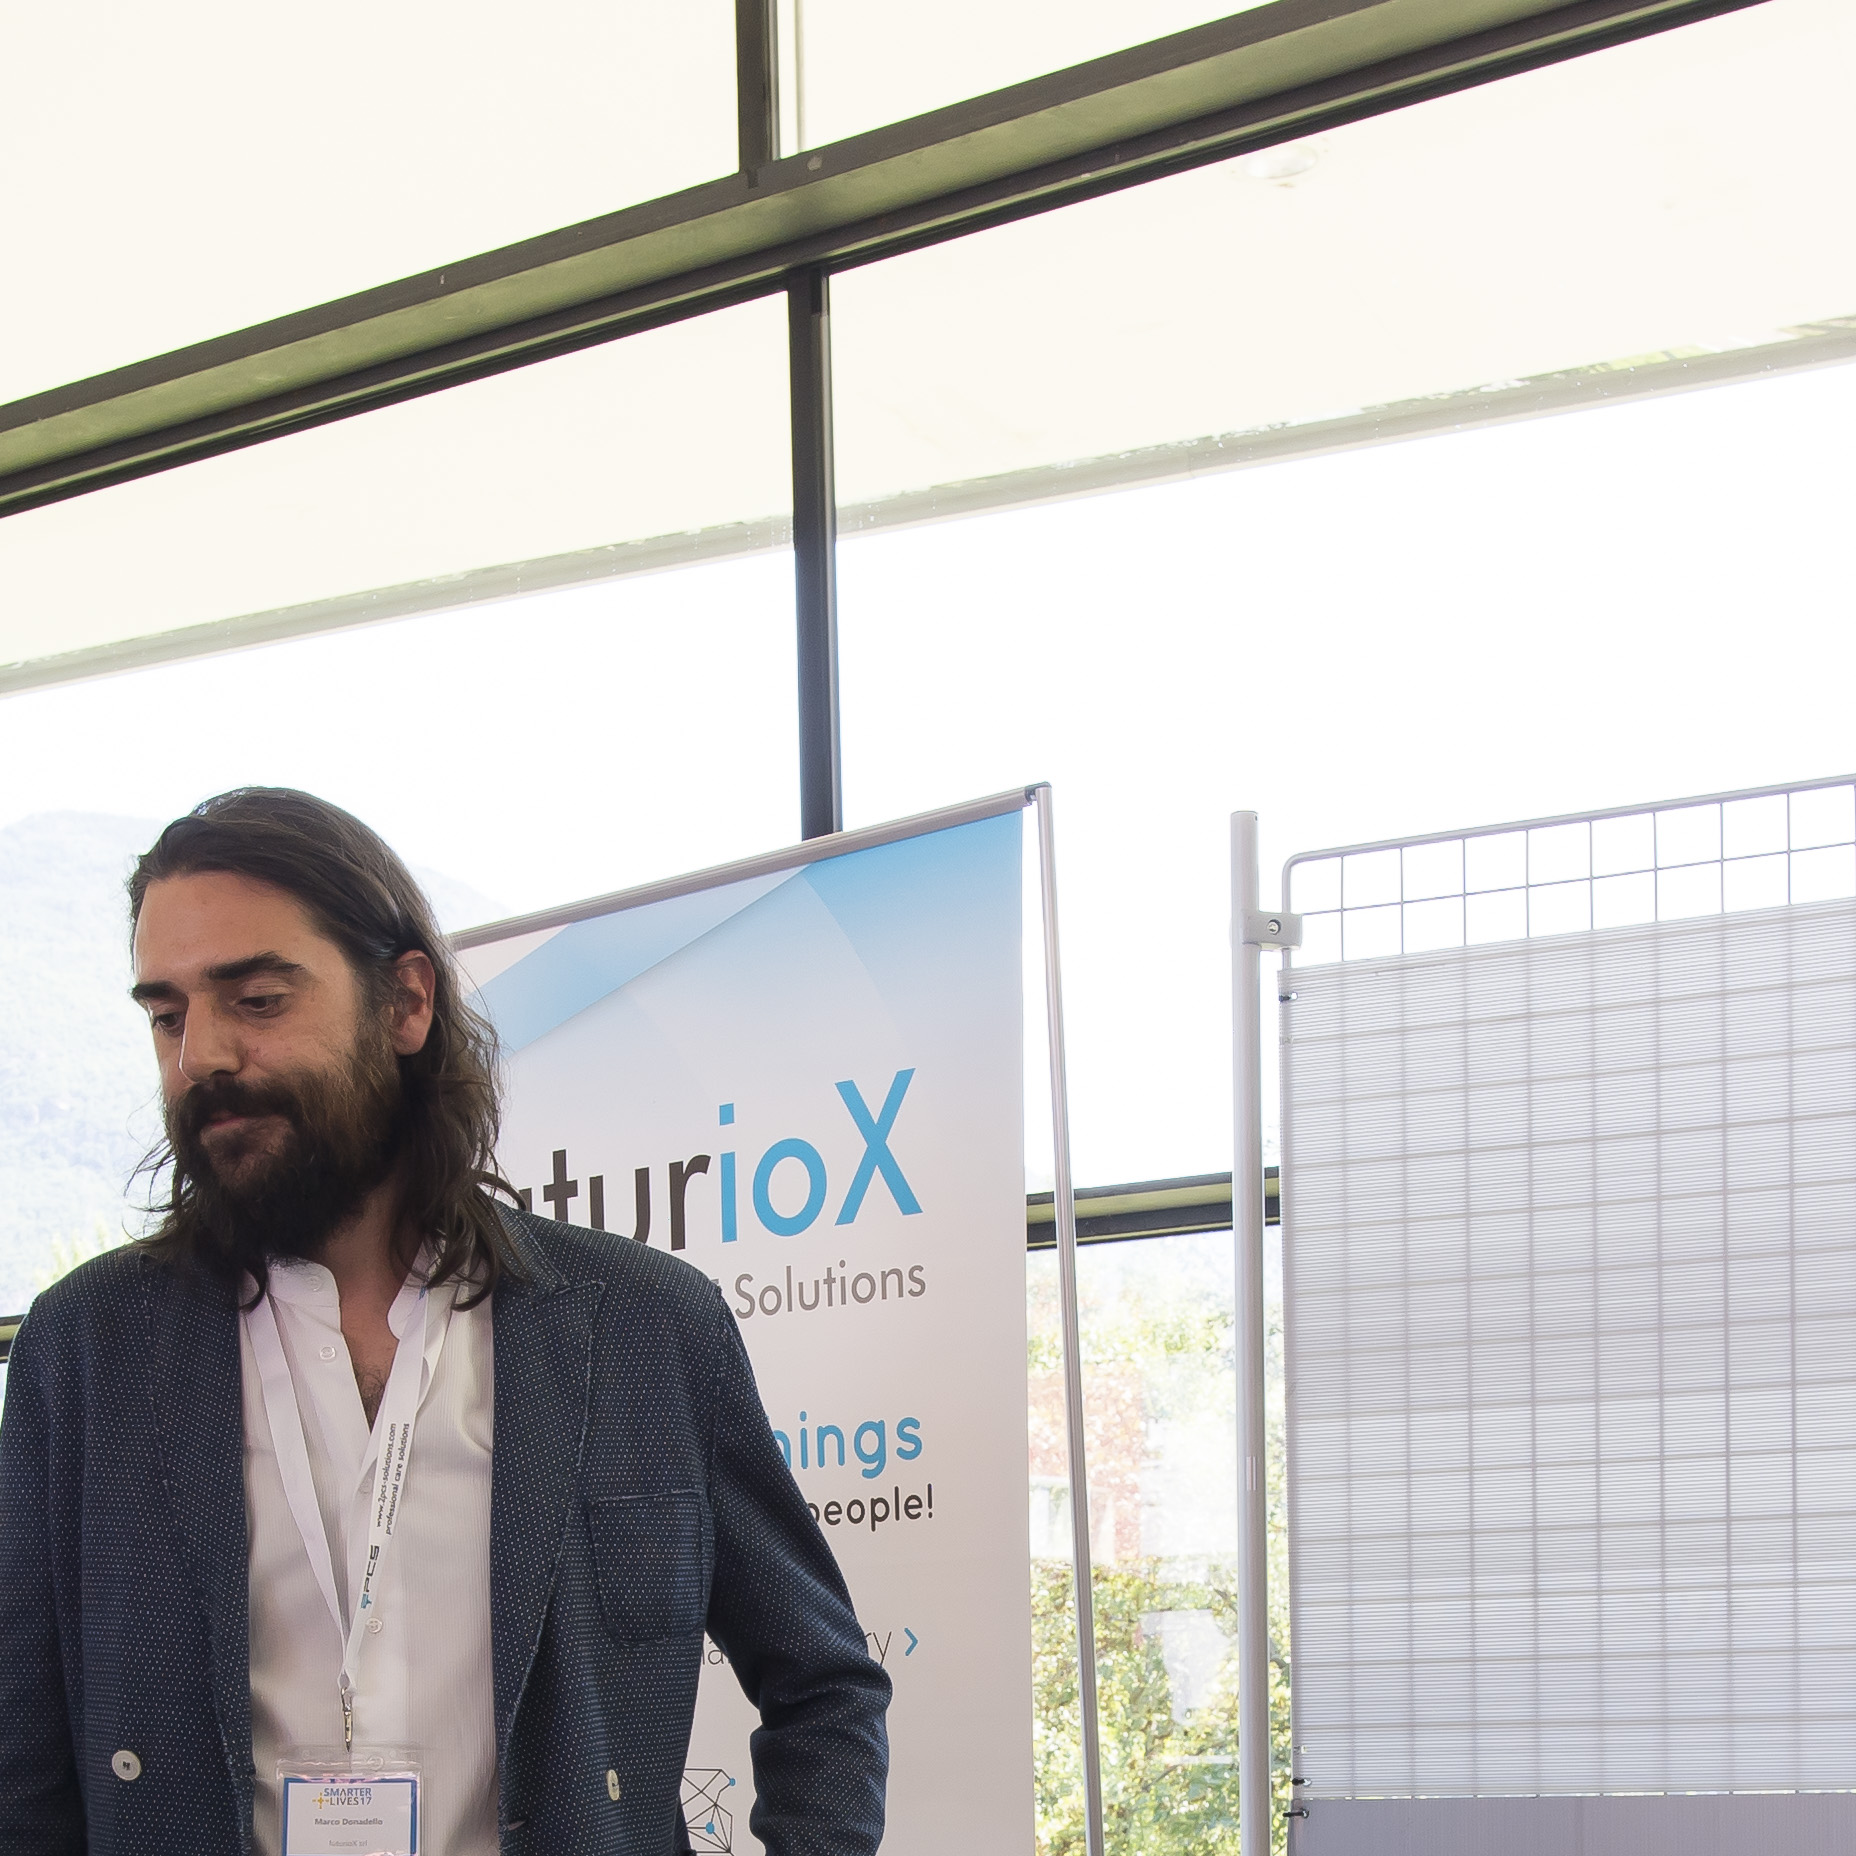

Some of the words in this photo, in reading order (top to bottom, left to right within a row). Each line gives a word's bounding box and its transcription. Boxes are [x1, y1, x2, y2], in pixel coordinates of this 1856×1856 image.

[520, 1067, 923, 1251] turioX
[734, 1259, 927, 1320] Solutions
[398, 1422, 410, 1461] solutions
[772, 1411, 922, 1479] ings
[376, 1422, 396, 1528] www.2pcs-solutions.com
[395, 1463, 403, 1482] care
[385, 1482, 399, 1535] professional
[324, 1787, 372, 1797] SMARTER
[314, 1818, 341, 1826] Marco
[342, 1818, 383, 1826] Donadello
